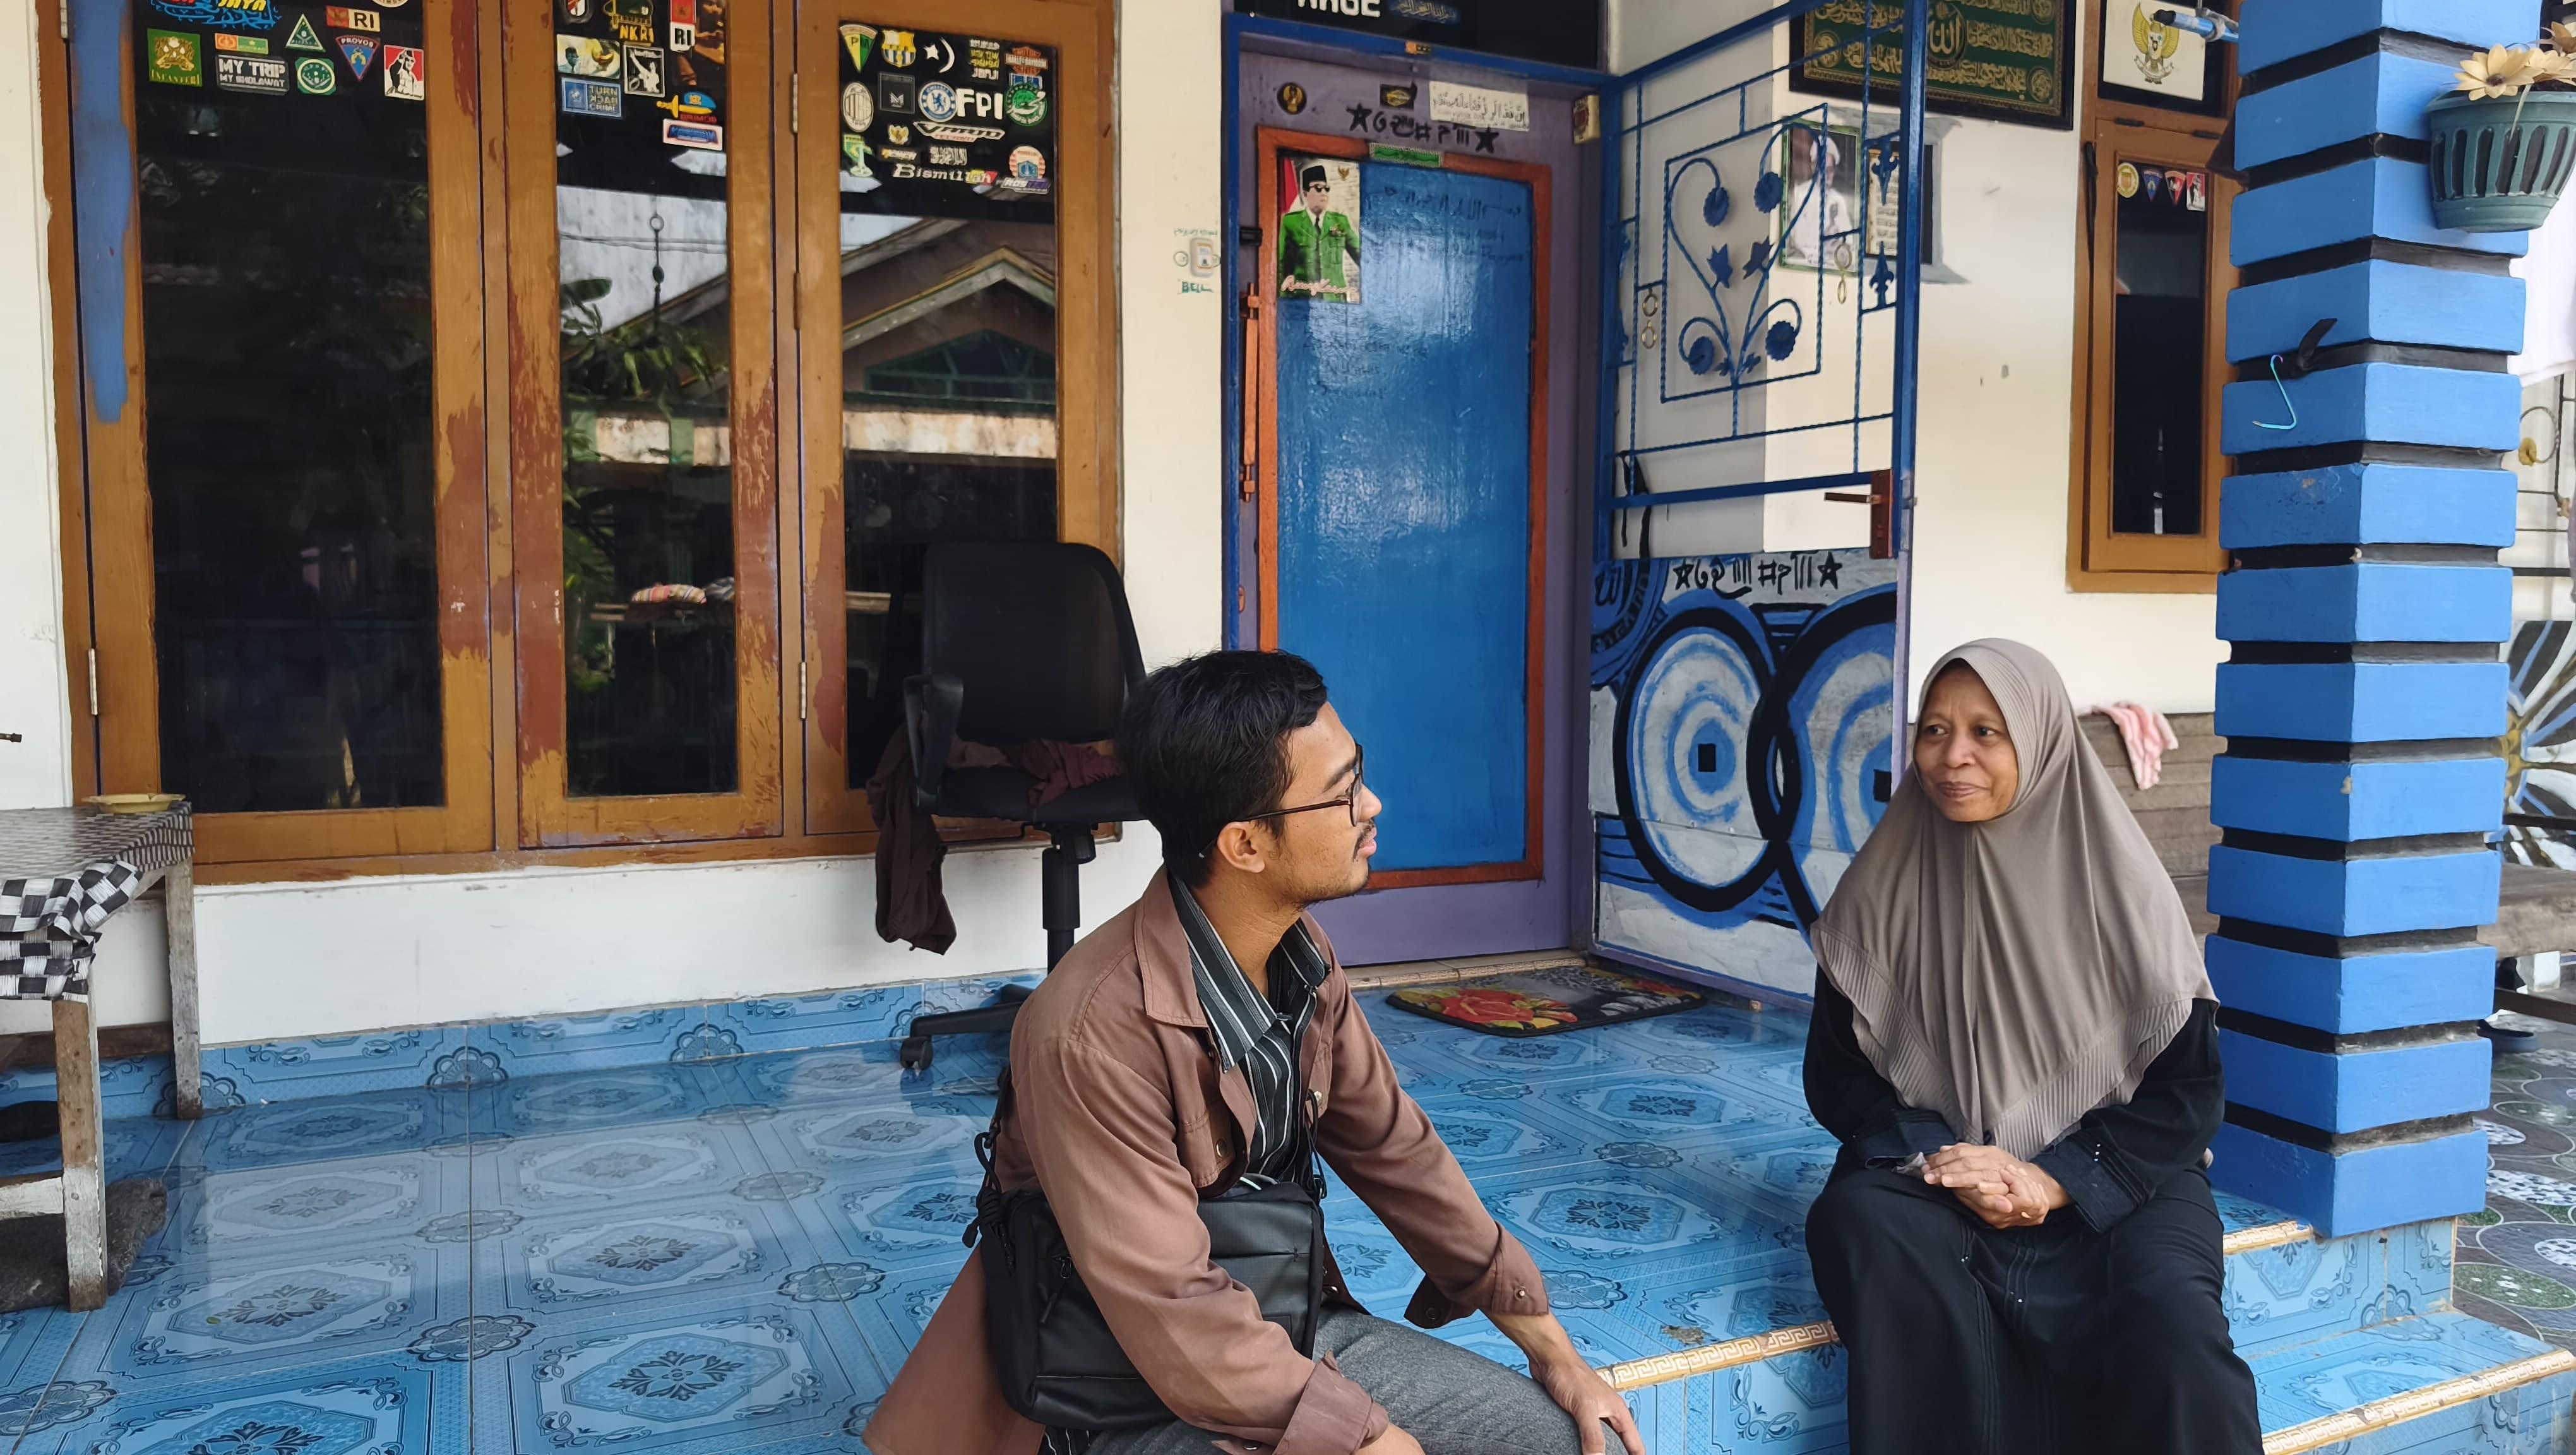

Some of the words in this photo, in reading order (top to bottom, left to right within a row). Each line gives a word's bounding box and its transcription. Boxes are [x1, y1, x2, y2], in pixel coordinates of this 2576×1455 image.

[354, 11, 374, 28] RI
[620, 25, 654, 43] NKRI
[674, 28, 692, 46] RI
[218, 58, 244, 74] MY
[248, 62, 285, 78] TRIP
[220, 74, 234, 83] MY
[956, 88, 1003, 120] FPI
[1181, 281, 1213, 294] BELL
